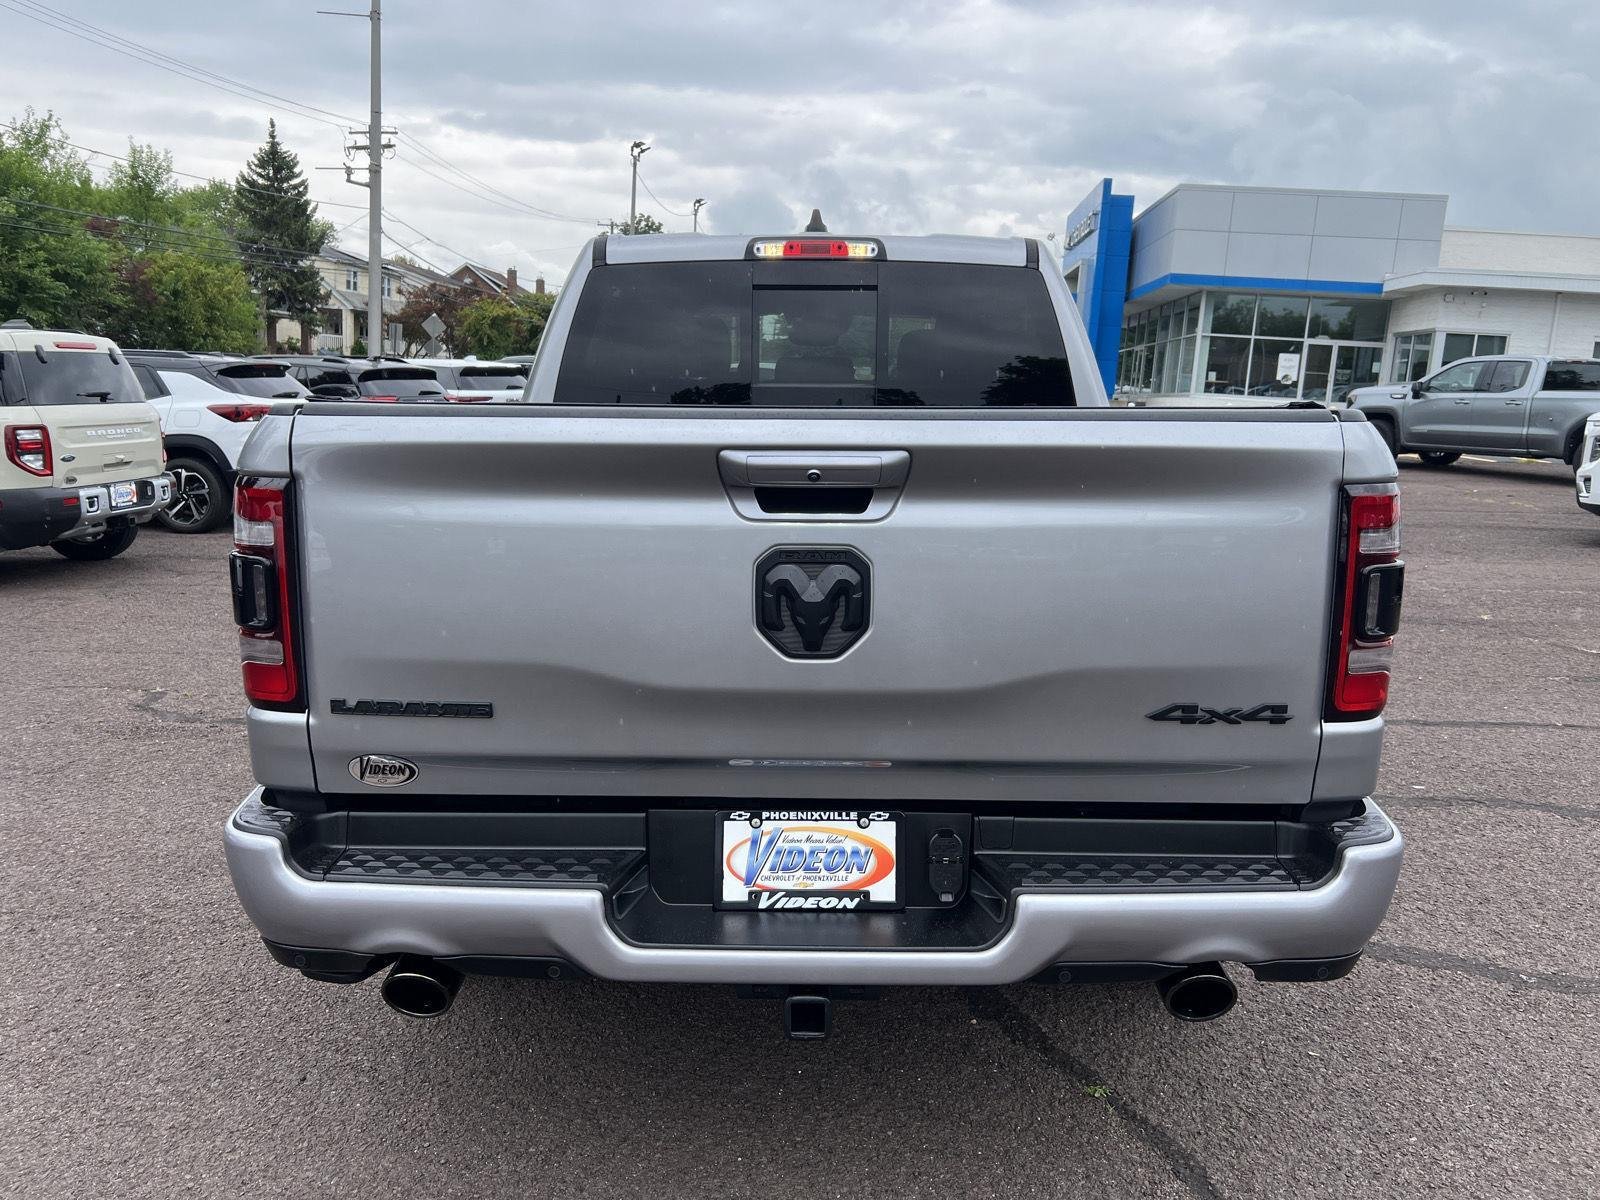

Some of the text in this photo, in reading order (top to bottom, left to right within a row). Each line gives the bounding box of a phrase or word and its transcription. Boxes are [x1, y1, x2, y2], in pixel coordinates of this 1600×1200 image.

[780, 551, 846, 560] RAM
[330, 699, 493, 719] LARAMIE
[360, 756, 406, 781] VIDEON
[761, 811, 858, 821] PHOENIXVILLE
[743, 827, 873, 888] VIDEON
[761, 874, 795, 882] CHEVROLET
[802, 874, 849, 882] PHOENIXVILLE
[757, 891, 860, 910] VIDEON
